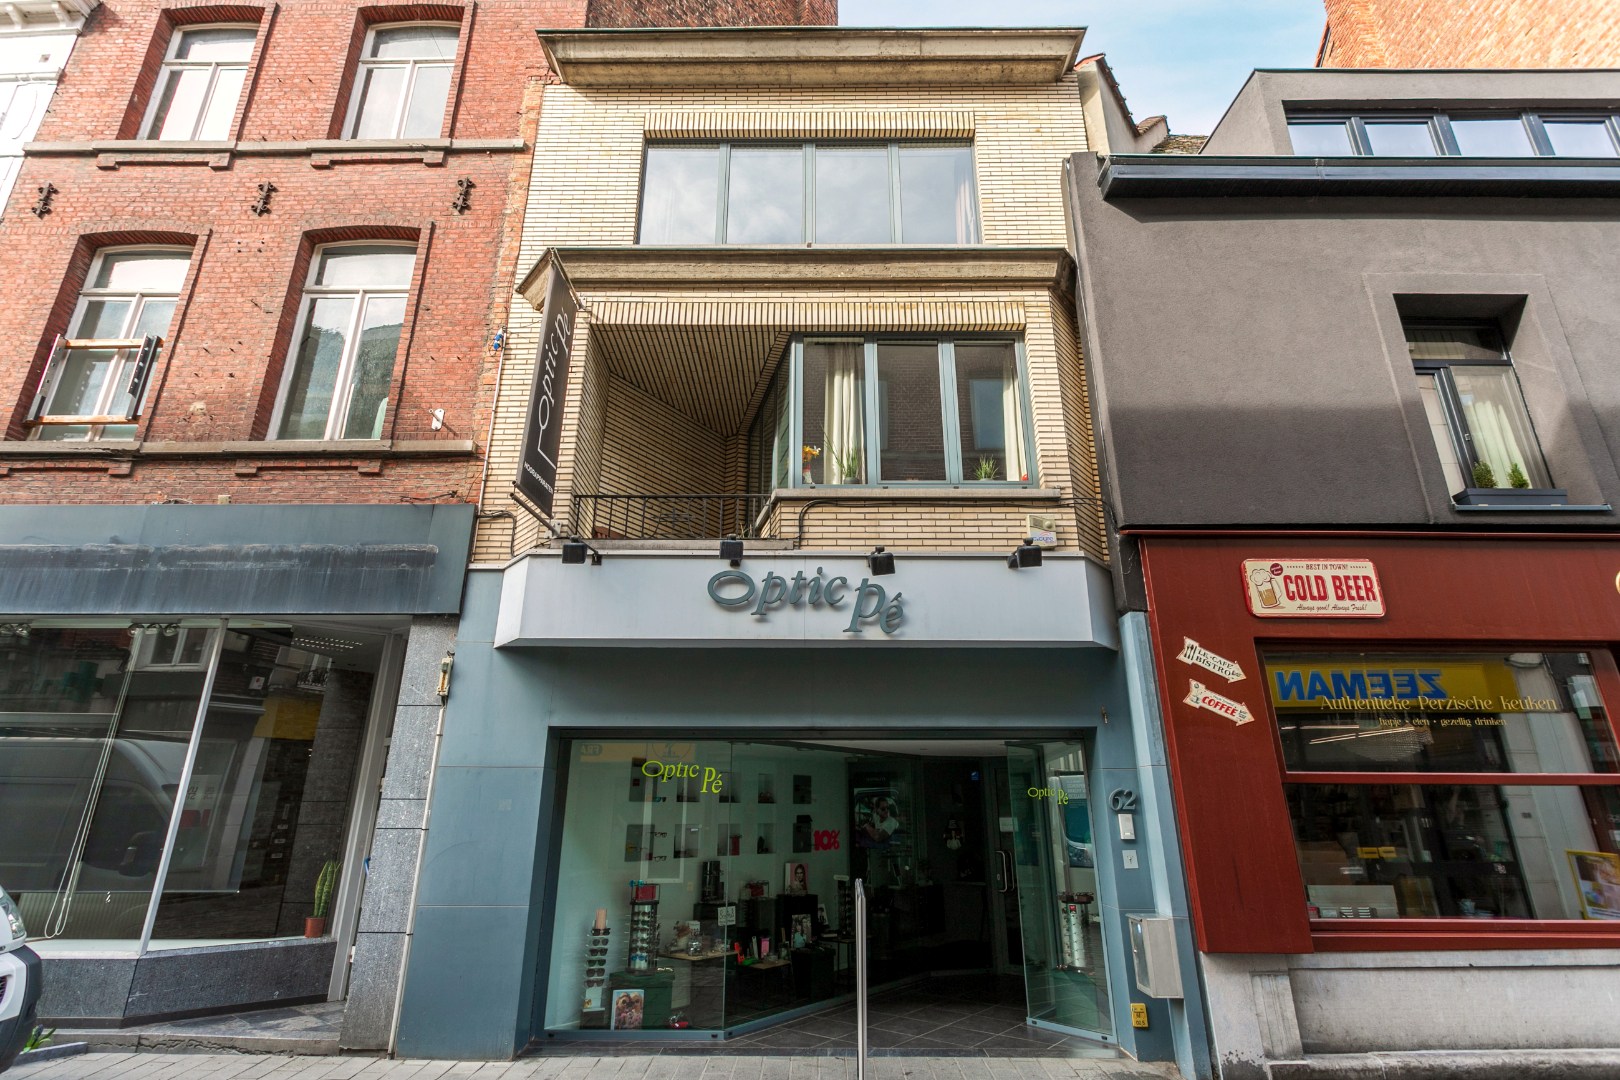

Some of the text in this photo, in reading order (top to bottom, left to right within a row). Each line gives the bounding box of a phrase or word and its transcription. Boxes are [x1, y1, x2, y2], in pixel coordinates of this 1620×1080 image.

[538, 332, 559, 430] Optic
[1305, 563, 1348, 571] BEST IN TOWN!
[1283, 574, 1378, 602] COLD BEER
[706, 566, 904, 634] Optic Pé
[1195, 656, 1231, 677] BISTRO
[1201, 696, 1238, 717] COFFEE
[1320, 695, 1557, 710] Authentieke Perzische keuken
[1378, 717, 1506, 727] hapje eten gezellig drinken
[641, 759, 723, 794] Optic Pé
[1027, 786, 1057, 801] Optic
[1057, 789, 1069, 806] Pé
[1108, 787, 1138, 812] 62
